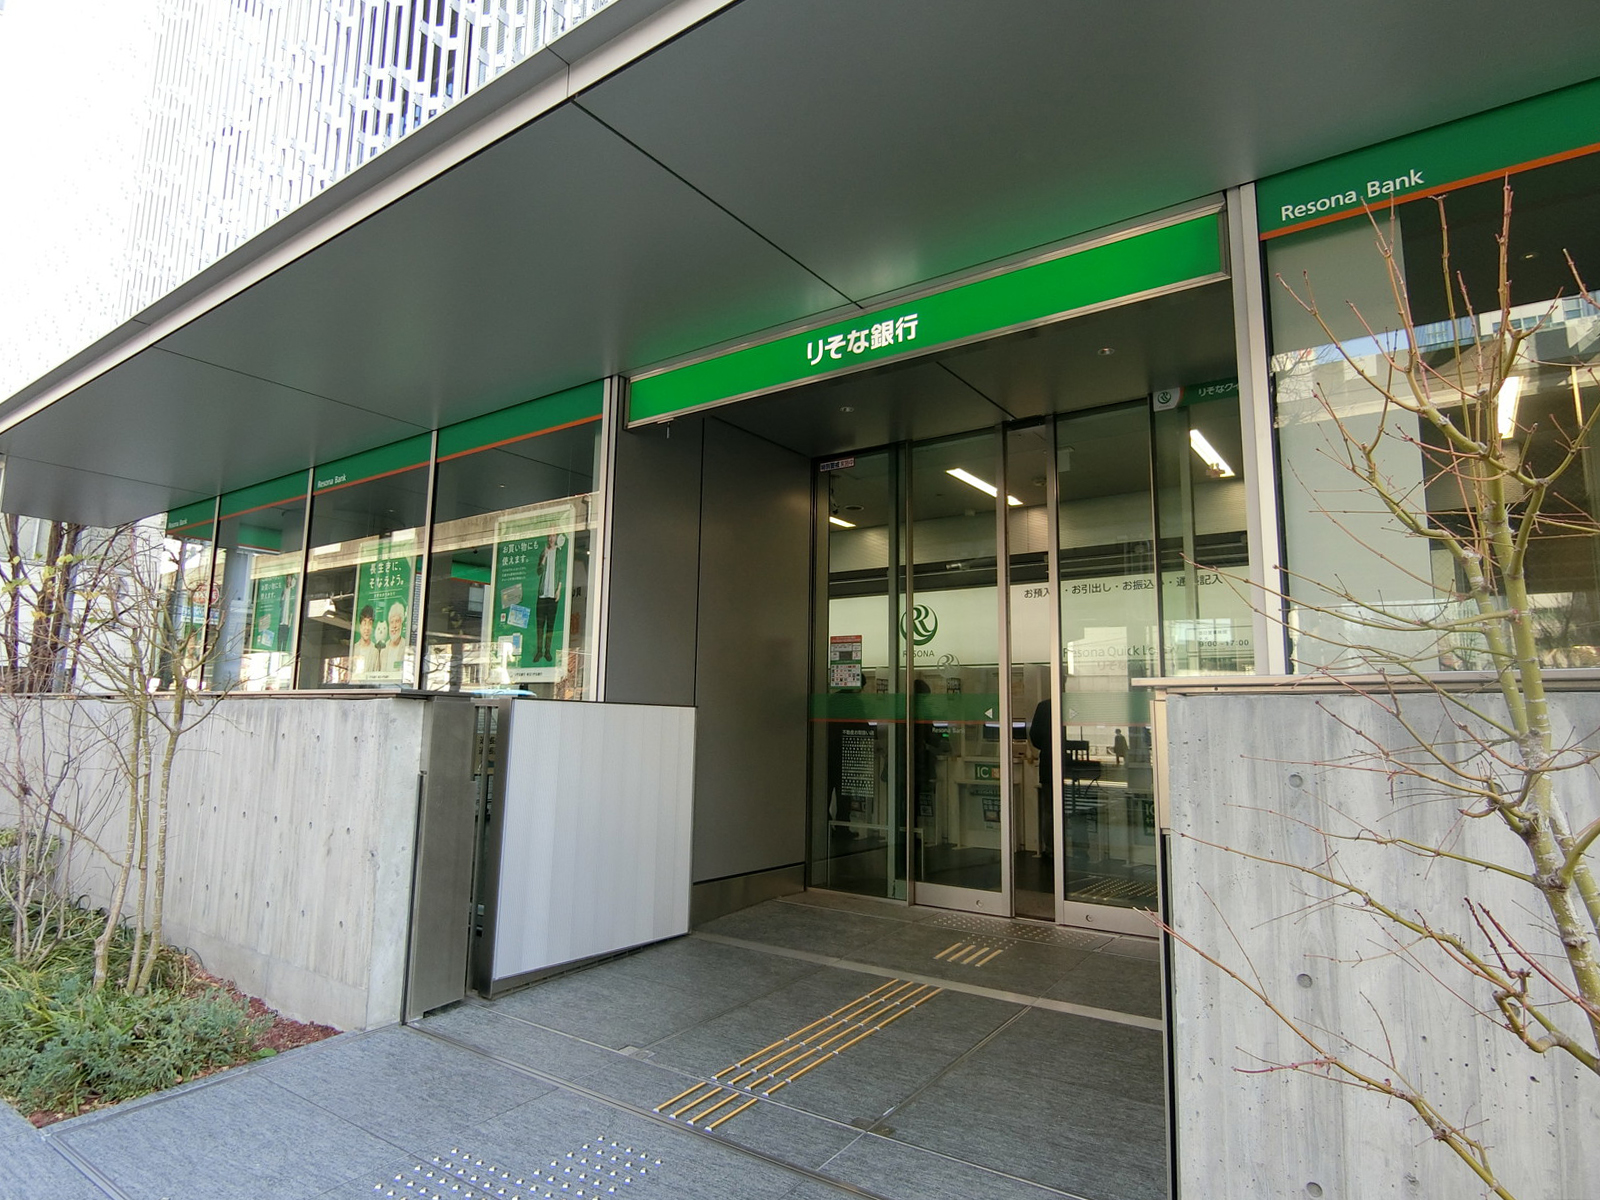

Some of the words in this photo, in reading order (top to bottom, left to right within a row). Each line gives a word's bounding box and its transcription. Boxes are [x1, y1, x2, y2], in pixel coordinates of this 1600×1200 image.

[1281, 190, 1357, 221] Resona
[1366, 169, 1425, 198] Bank
[807, 313, 919, 366] りそな銀行
[317, 479, 334, 488] Resona
[335, 473, 347, 484] Bank
[502, 540, 539, 554] お買い物にも
[502, 554, 529, 566] 使えます。
[369, 561, 402, 575] 長生きに、
[369, 574, 404, 589] そなえよう。
[1107, 645, 1140, 657] Quick
[976, 766, 990, 778] IC
